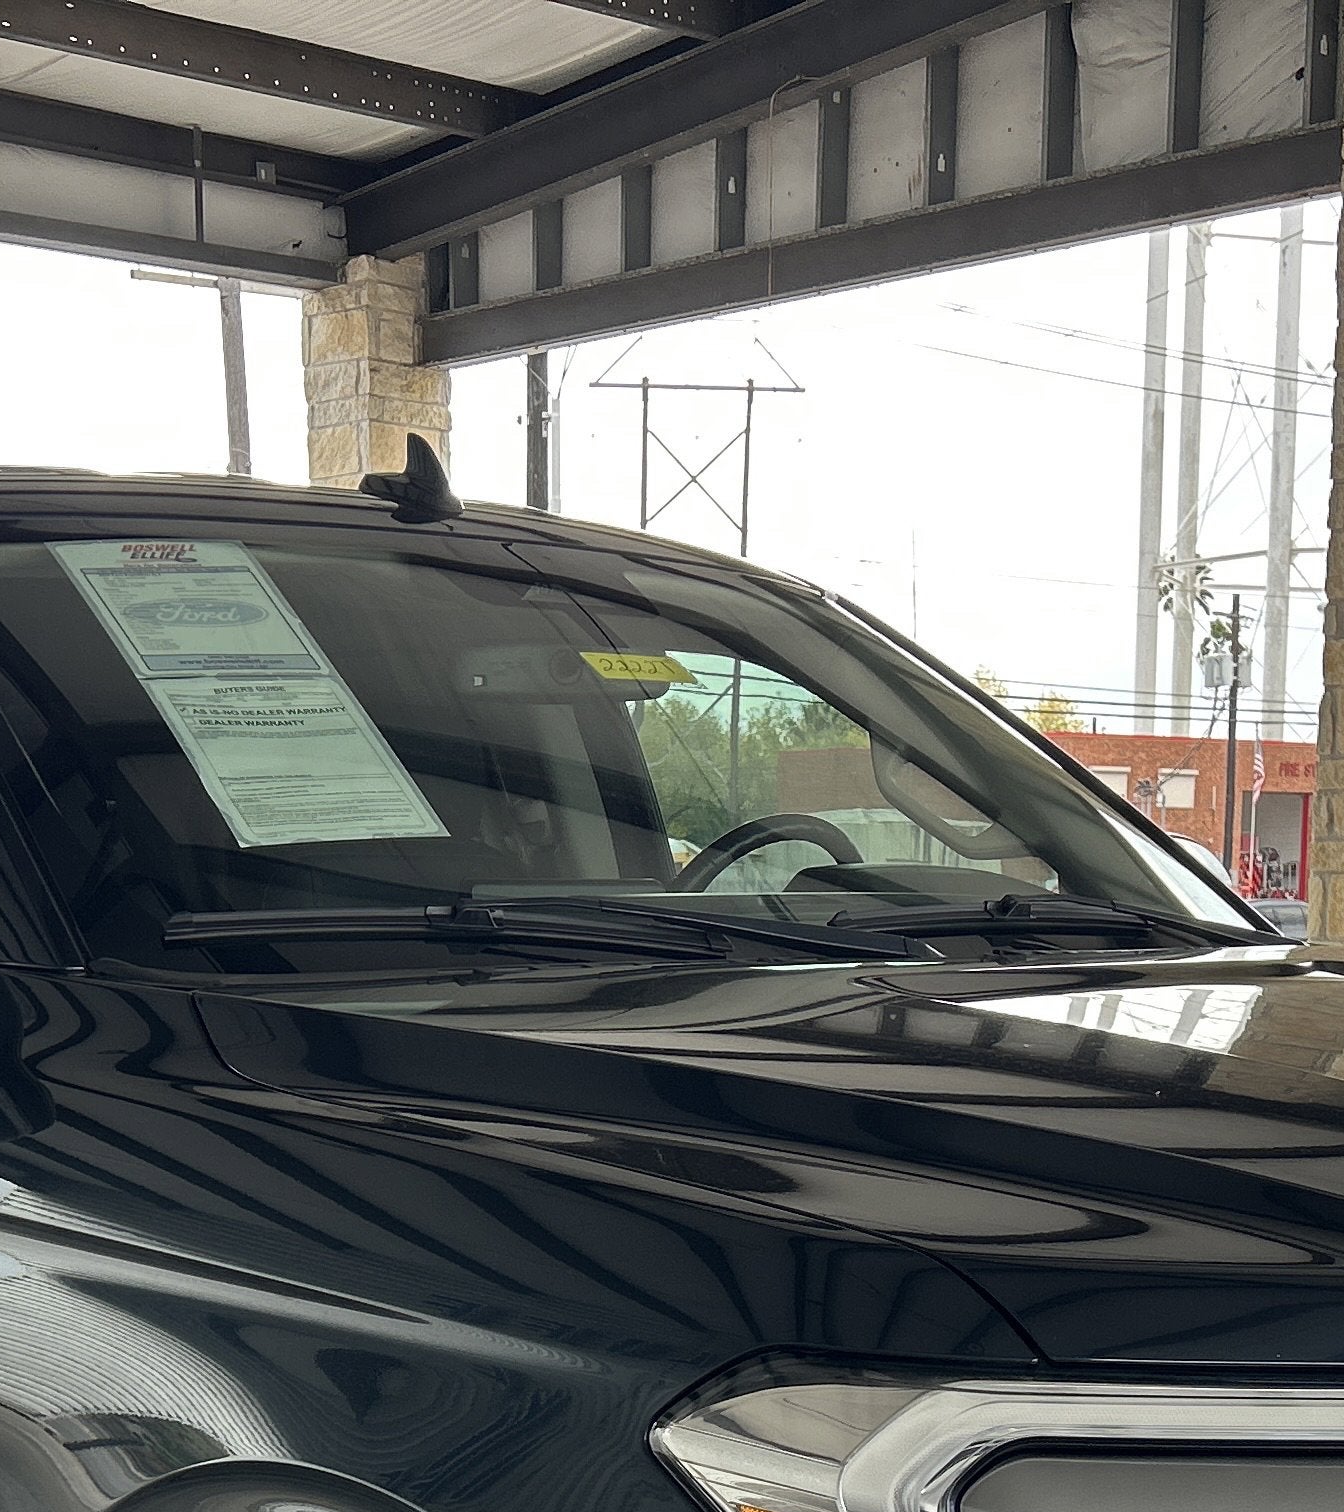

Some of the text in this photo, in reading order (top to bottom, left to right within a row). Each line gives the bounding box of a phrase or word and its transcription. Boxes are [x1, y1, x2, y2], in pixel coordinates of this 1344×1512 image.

[242, 708, 284, 716] DEALER
[287, 706, 346, 716] WARRANTY
[245, 719, 305, 727] WARRANTY
